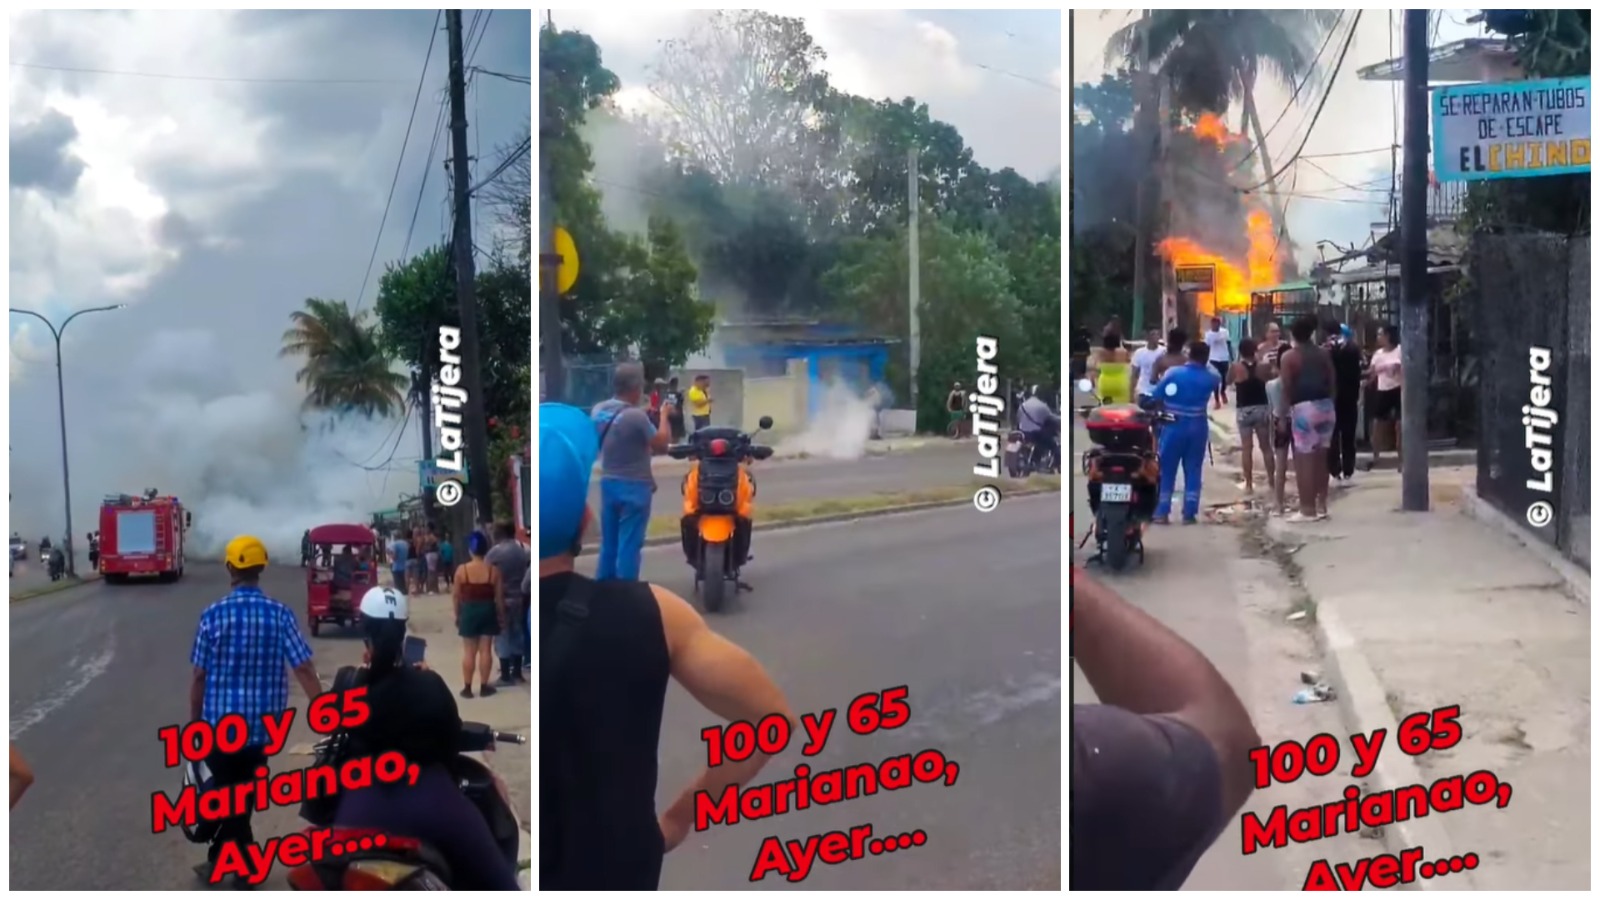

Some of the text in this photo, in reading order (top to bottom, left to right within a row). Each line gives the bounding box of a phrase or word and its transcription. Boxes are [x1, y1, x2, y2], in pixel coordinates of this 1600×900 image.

[1440, 87, 1585, 116] SE REPARAN TUBOS
[1478, 114, 1563, 139] DE ESCAPE
[1460, 138, 1591, 172] EL CHINO
